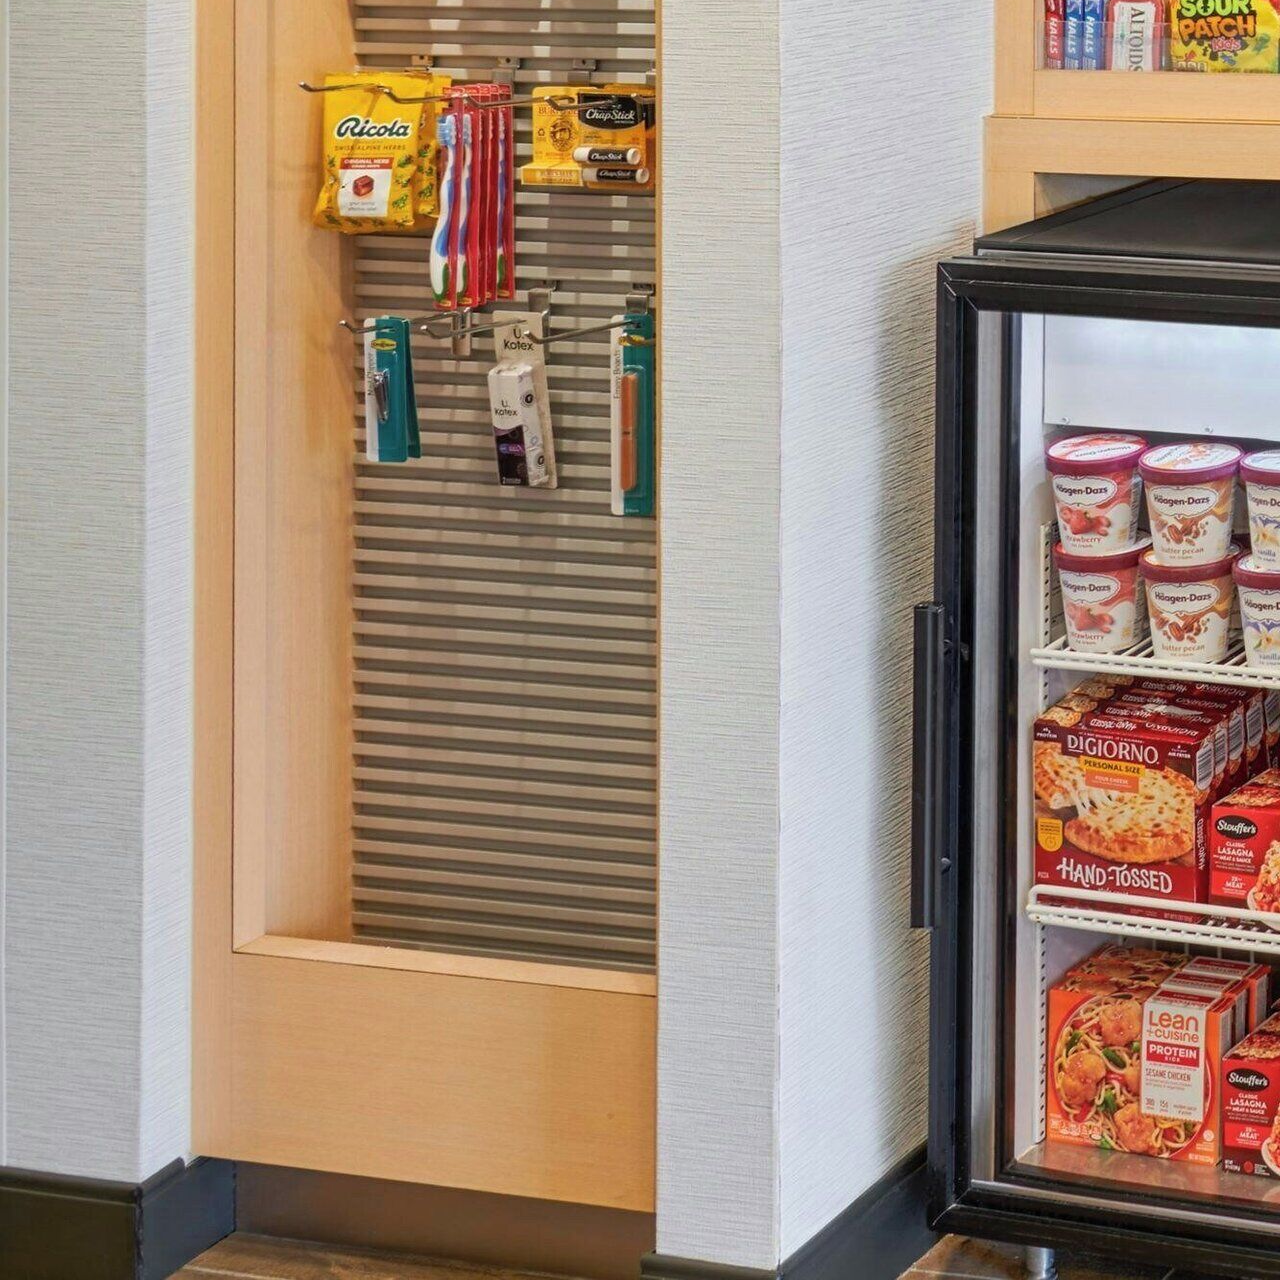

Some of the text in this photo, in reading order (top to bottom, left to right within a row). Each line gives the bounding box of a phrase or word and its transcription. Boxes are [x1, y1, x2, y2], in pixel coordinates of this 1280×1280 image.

[1050, 17, 1058, 53] HALLS
[1067, 17, 1075, 53] HALLS
[1180, 16, 1256, 38] PATCH
[585, 108, 635, 121] ChapStick
[335, 117, 410, 139] Ricola
[503, 339, 535, 352] Kotex
[1084, 759, 1141, 774] PERSONAL SIZE
[1217, 820, 1257, 836] Stouffer's
[1217, 847, 1254, 858] LASAGNA
[1057, 858, 1173, 894] HAND-TOSSED
[1148, 1010, 1199, 1031] Lean
[1149, 1045, 1196, 1061] PROTEIN
[1229, 1072, 1268, 1088] Stouffer's
